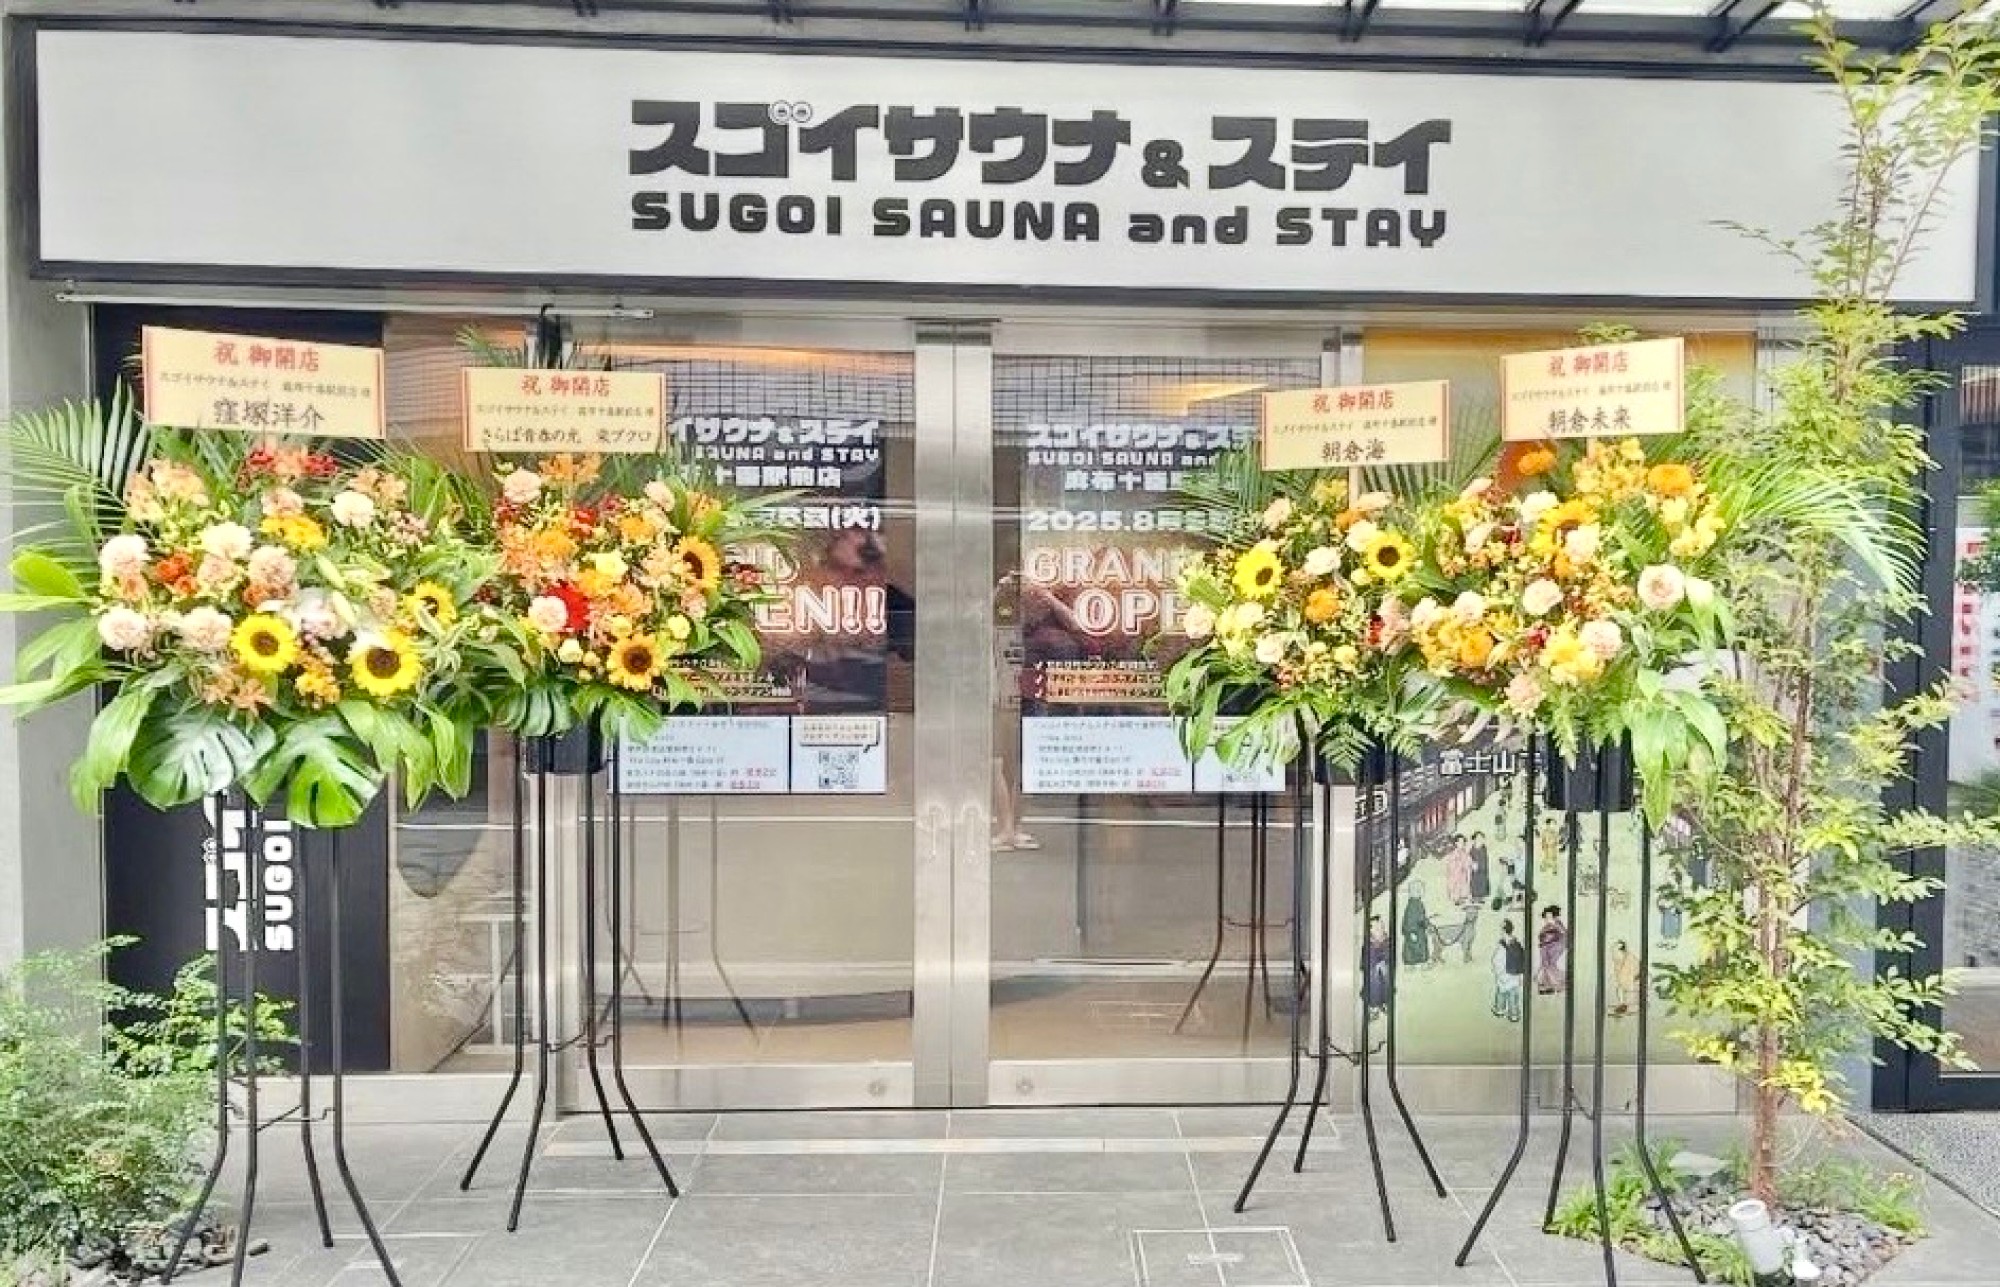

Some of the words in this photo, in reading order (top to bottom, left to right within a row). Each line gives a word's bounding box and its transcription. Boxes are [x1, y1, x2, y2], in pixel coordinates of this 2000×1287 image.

[631, 191, 842, 236] SUGOI
[872, 196, 1101, 243] SAUNA
[1128, 205, 1249, 245] and
[1276, 207, 1446, 248] STAY
[214, 341, 240, 366] 祝
[248, 344, 320, 372] 御開店
[774, 447, 814, 461] and
[821, 448, 879, 462] STAY
[1028, 451, 1093, 466] SUGOI
[1102, 451, 1174, 466] SAUNA
[751, 585, 888, 635] EN!!
[263, 820, 295, 952] SUGOI
